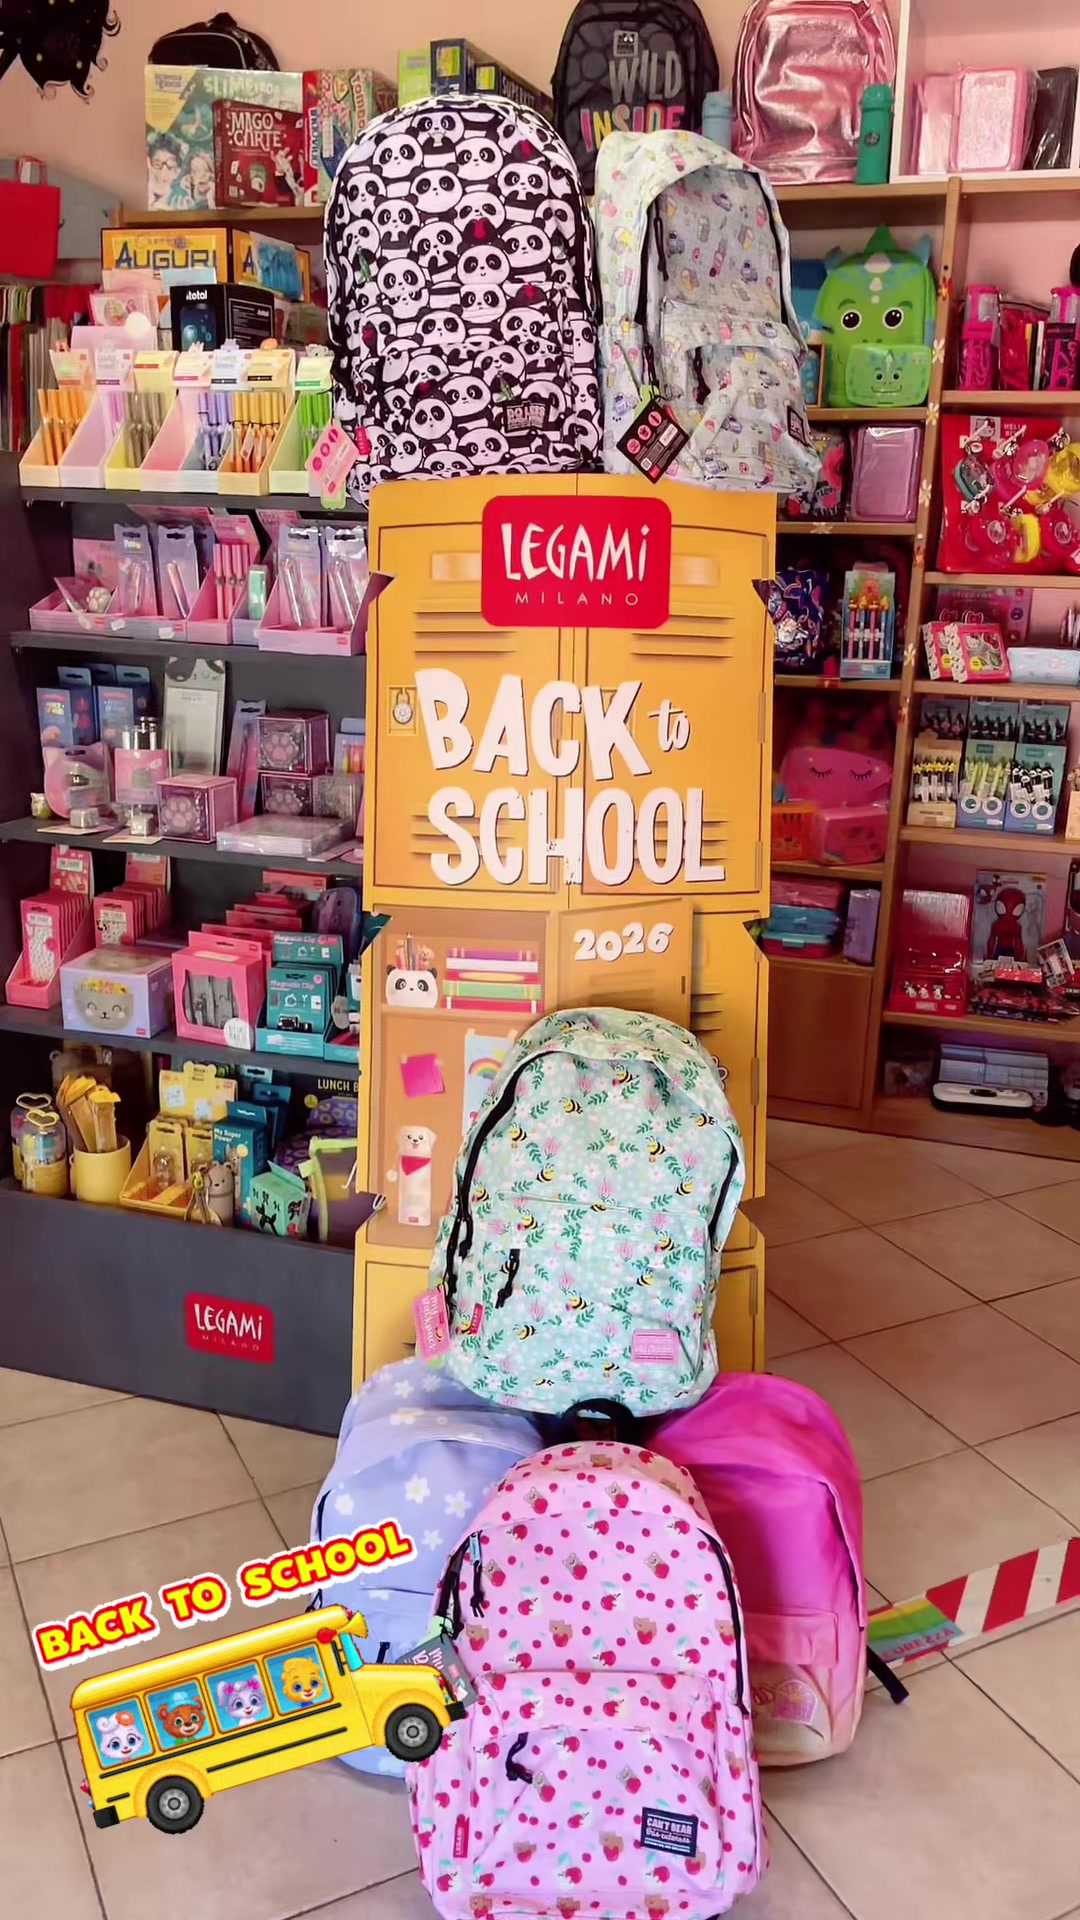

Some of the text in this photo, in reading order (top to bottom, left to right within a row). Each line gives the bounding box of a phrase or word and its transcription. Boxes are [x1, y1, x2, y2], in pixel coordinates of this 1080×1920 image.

[609, 49, 682, 104] WILD
[228, 111, 274, 135] MAGO
[580, 103, 685, 152] INSIDE
[232, 128, 282, 151] CARTE
[115, 240, 217, 269] AUGURI
[515, 592, 639, 606] MILANO
[415, 668, 691, 781] BACK to
[427, 786, 725, 885] SCHOOL
[573, 922, 674, 960] 2026
[317, 1078, 359, 1092] LUNCH B
[202, 1334, 259, 1351] MILANO
